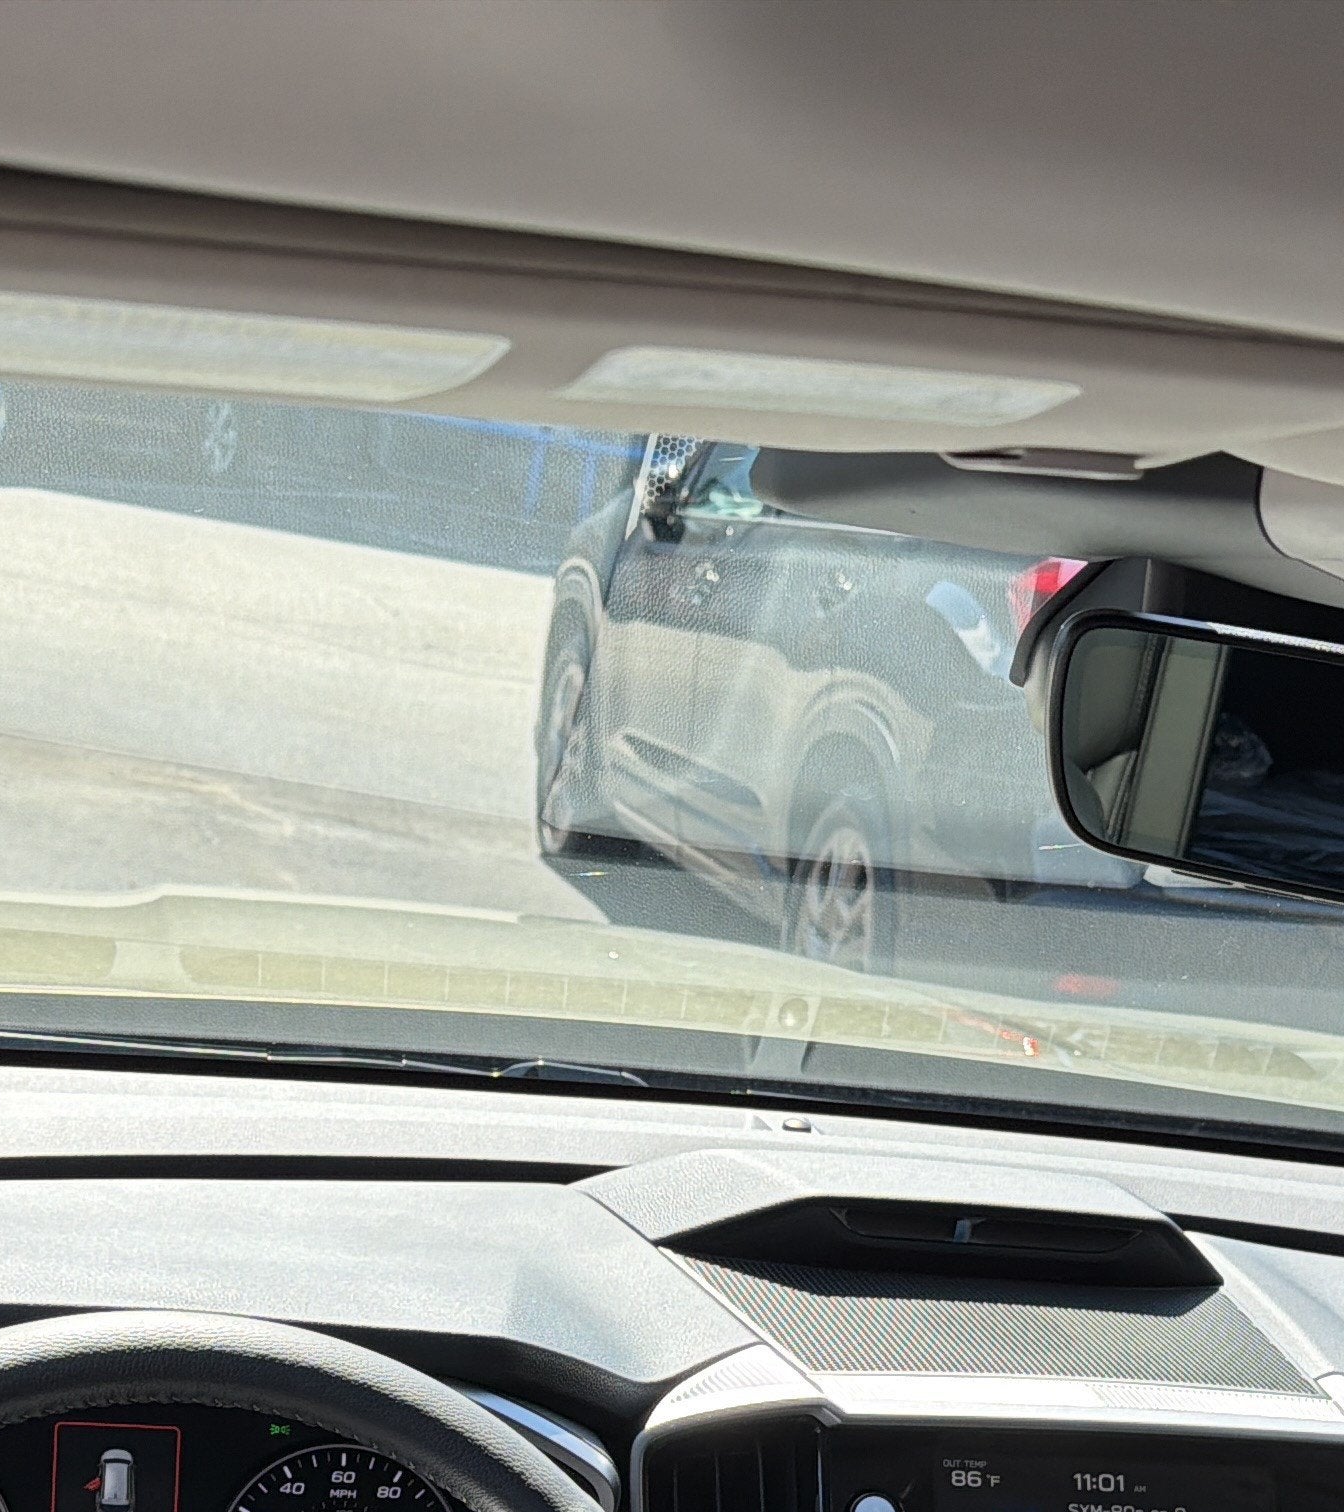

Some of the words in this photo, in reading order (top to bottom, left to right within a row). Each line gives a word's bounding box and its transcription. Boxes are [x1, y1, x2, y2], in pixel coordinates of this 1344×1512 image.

[942, 1459, 962, 1468] OUT
[963, 1460, 987, 1468] TEMP
[331, 1470, 356, 1484] 60
[951, 1470, 982, 1488] 86
[1073, 1473, 1125, 1492] 11:01
[1134, 1485, 1147, 1493] AM
[279, 1482, 305, 1495] 40
[329, 1489, 357, 1499] MPH
[376, 1486, 401, 1499] 80
